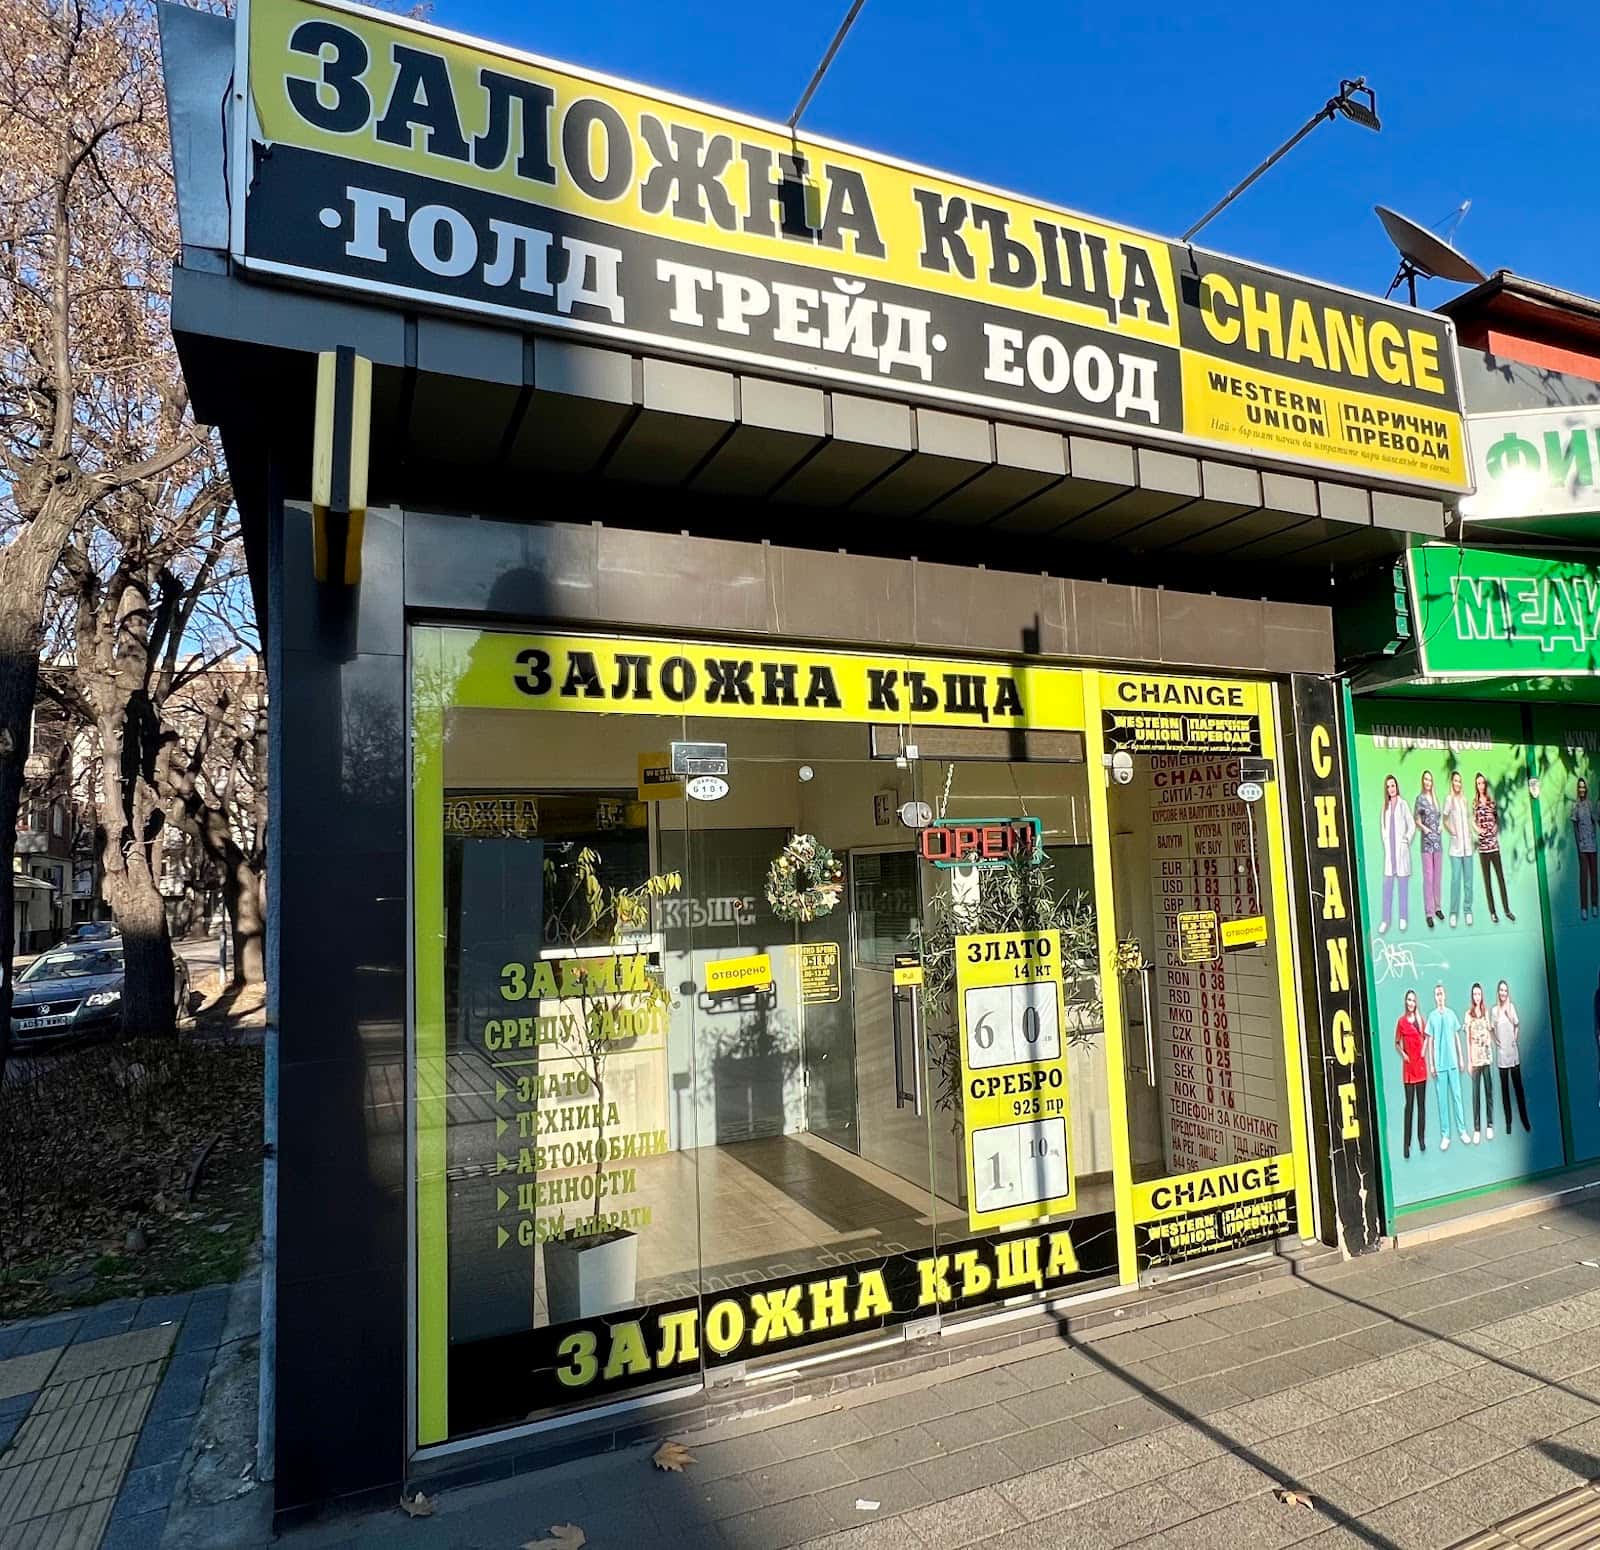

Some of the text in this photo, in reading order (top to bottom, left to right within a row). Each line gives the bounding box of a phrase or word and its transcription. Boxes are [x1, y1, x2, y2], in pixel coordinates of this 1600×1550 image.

[288, 21, 1168, 326] ЗАЛОЖНА КЪЩА
[1200, 272, 1445, 395] CHANGE
[983, 322, 1159, 424] ЕООД
[1208, 371, 1322, 415] WESTERN
[1246, 404, 1325, 437] UNION
[1344, 403, 1447, 439] ПАРИЧНИ
[1346, 425, 1450, 460] ПРЕВОДИ
[1486, 430, 1600, 487] ФИ
[513, 649, 1024, 723] ЗАЛОЖНА КЪЩА
[1117, 681, 1244, 707] CHANGE
[1114, 715, 1180, 729] WESTERN
[1135, 728, 1180, 742] UNION
[1189, 717, 1249, 731] ПАРИЧНИ
[1190, 730, 1250, 743] ПРЕВОДИ
[1371, 724, 1493, 752] WWW.GALIQ.COM
[1154, 762, 1240, 787] CHANG
[1208, 840, 1222, 855] BUY
[1162, 861, 1182, 875] EUR
[1162, 879, 1183, 893] USD
[1163, 898, 1184, 912] GBP
[1310, 724, 1361, 1139] CHANGE
[967, 937, 1051, 962] ЗЛАТО
[500, 953, 649, 1001] ЗАЕМИ
[711, 966, 766, 979] отворено
[1014, 964, 1030, 979] 14
[1168, 971, 1190, 986] RON
[1169, 989, 1191, 1004] RSD
[1169, 1007, 1192, 1023] MKD
[485, 1016, 574, 1051] СРЕЩУ
[1172, 1025, 1192, 1042] CZK
[1172, 1043, 1194, 1061] DKK
[970, 1068, 1062, 1100] СРЕБРО
[1174, 1062, 1195, 1080] SEK
[516, 1070, 590, 1101] ЗЛАТО
[1174, 1080, 1197, 1099] NOK
[516, 1102, 621, 1138] ТЕХНИКА
[1014, 1098, 1064, 1116] 925 пр
[1170, 1098, 1279, 1139] ТЕЛЕФОН ЗА КОНТАКТ
[517, 1130, 669, 1174] АВТОМОБИЛИ
[517, 1168, 637, 1212] ЦЕННОСТИ
[1151, 1164, 1281, 1210] CHANGE
[518, 1206, 653, 1246] GSM АПАРАТИ
[1148, 1214, 1216, 1240] WESTERN
[1170, 1227, 1216, 1248] UNION
[556, 1270, 893, 1387] ЗАЛОЖНА
[917, 1231, 1080, 1307] КЪЩА
